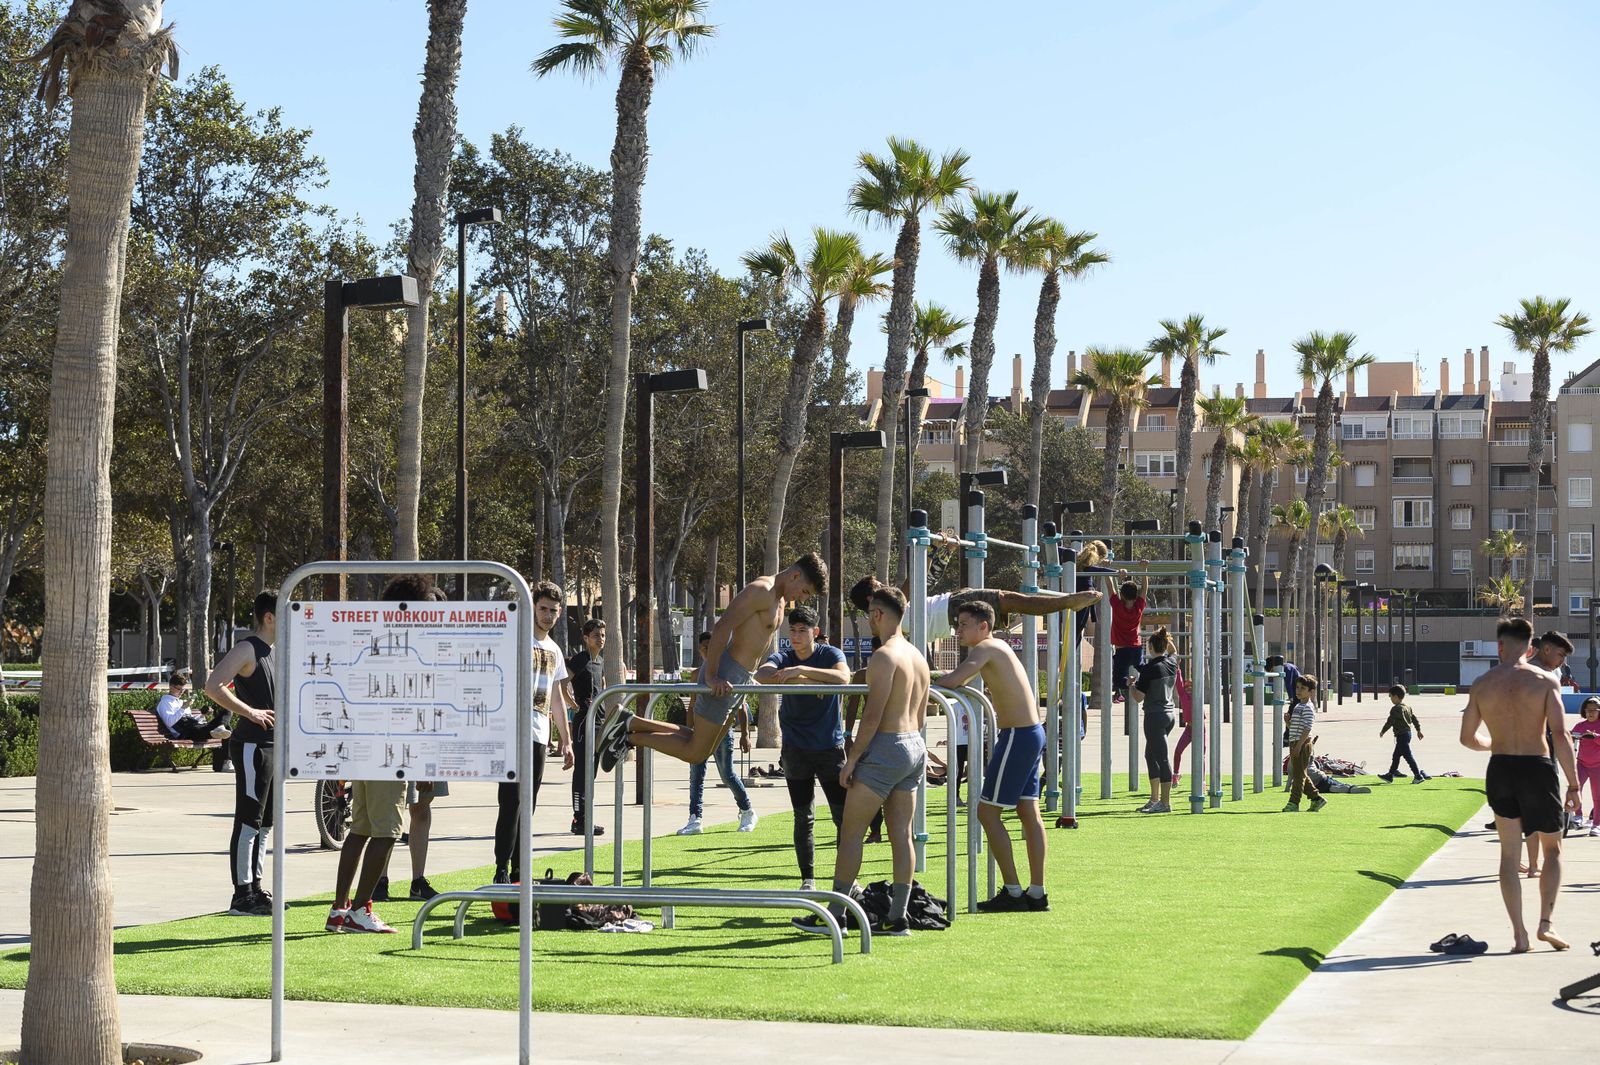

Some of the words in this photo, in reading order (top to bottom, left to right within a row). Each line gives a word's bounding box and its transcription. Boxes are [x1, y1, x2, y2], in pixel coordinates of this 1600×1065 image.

[332, 611, 378, 623] STREET
[383, 611, 444, 623] WORKOUT
[449, 608, 507, 623] ALMERÍA
